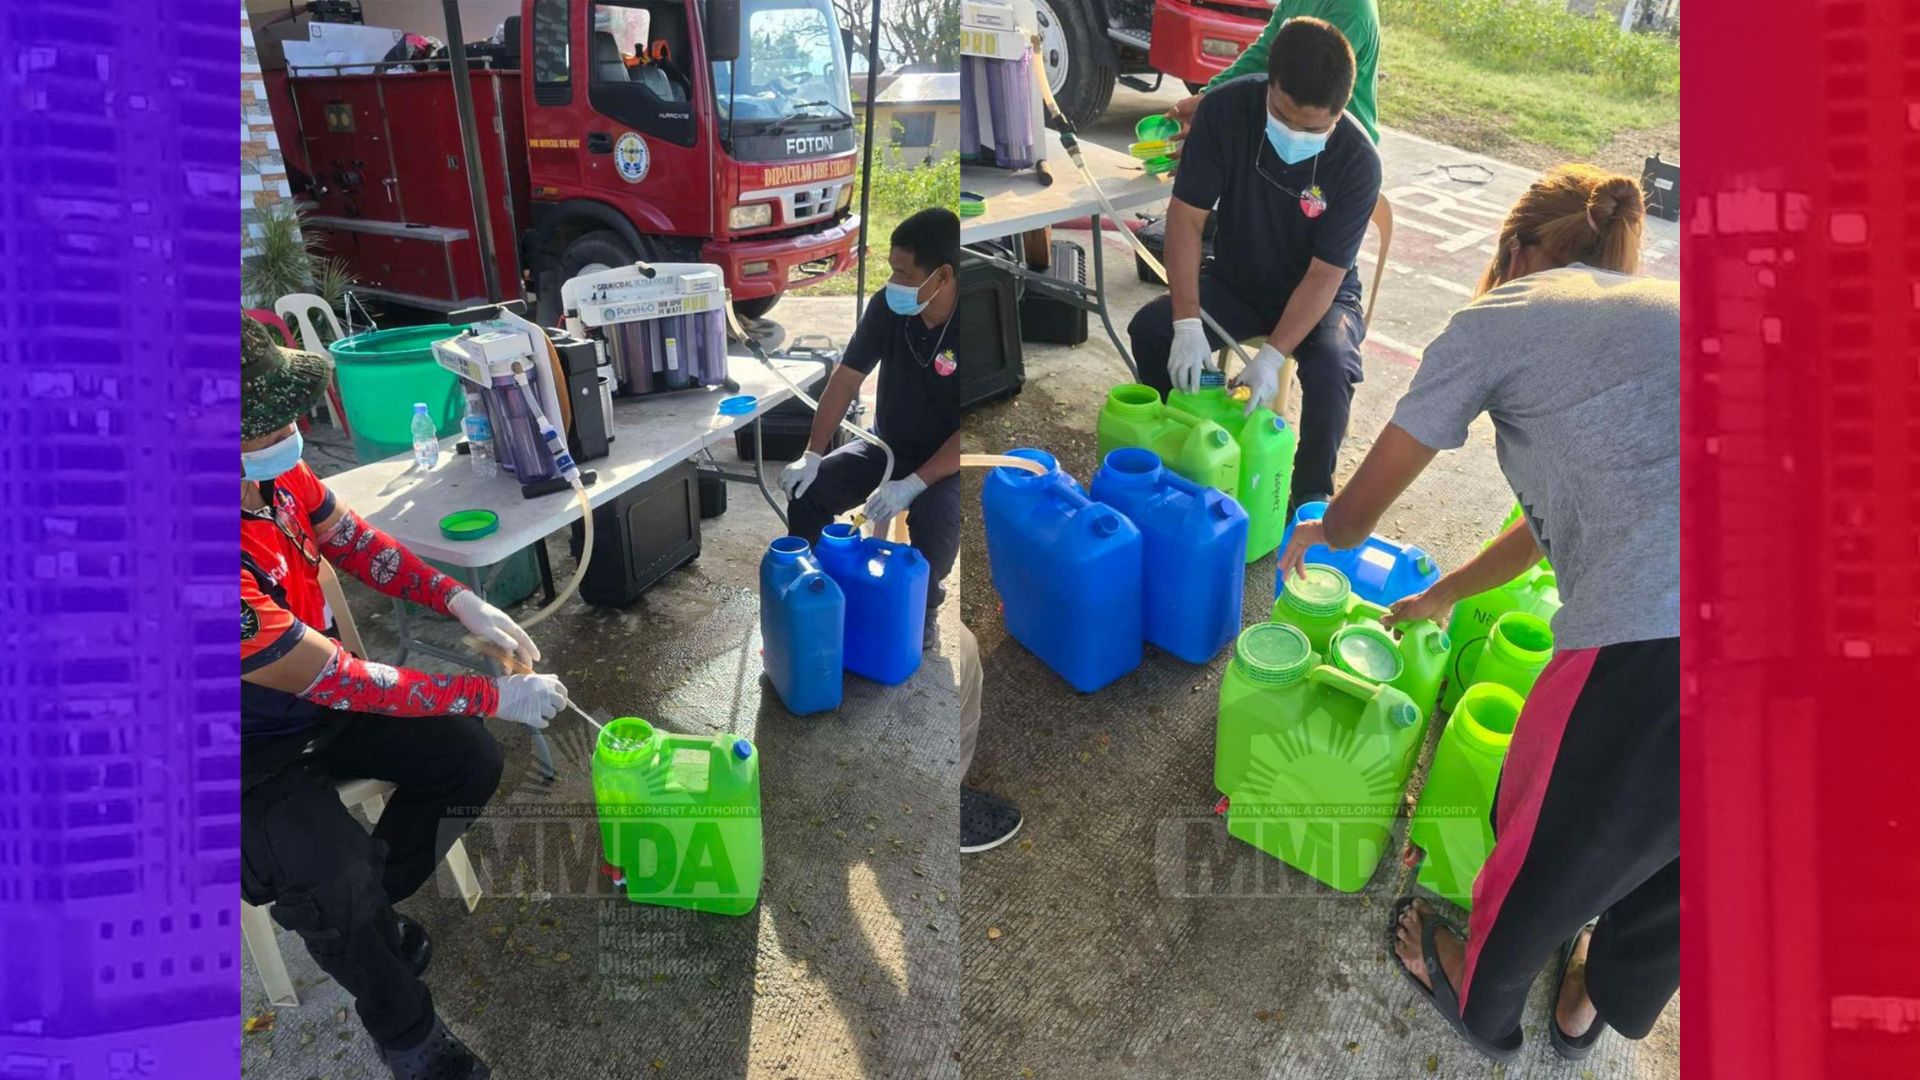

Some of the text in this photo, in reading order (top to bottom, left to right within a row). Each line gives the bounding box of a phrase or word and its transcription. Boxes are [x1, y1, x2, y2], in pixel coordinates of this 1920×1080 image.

[786, 136, 833, 154] FOTON
[764, 164, 812, 187] DIPACULAO
[813, 162, 829, 180] FIRE
